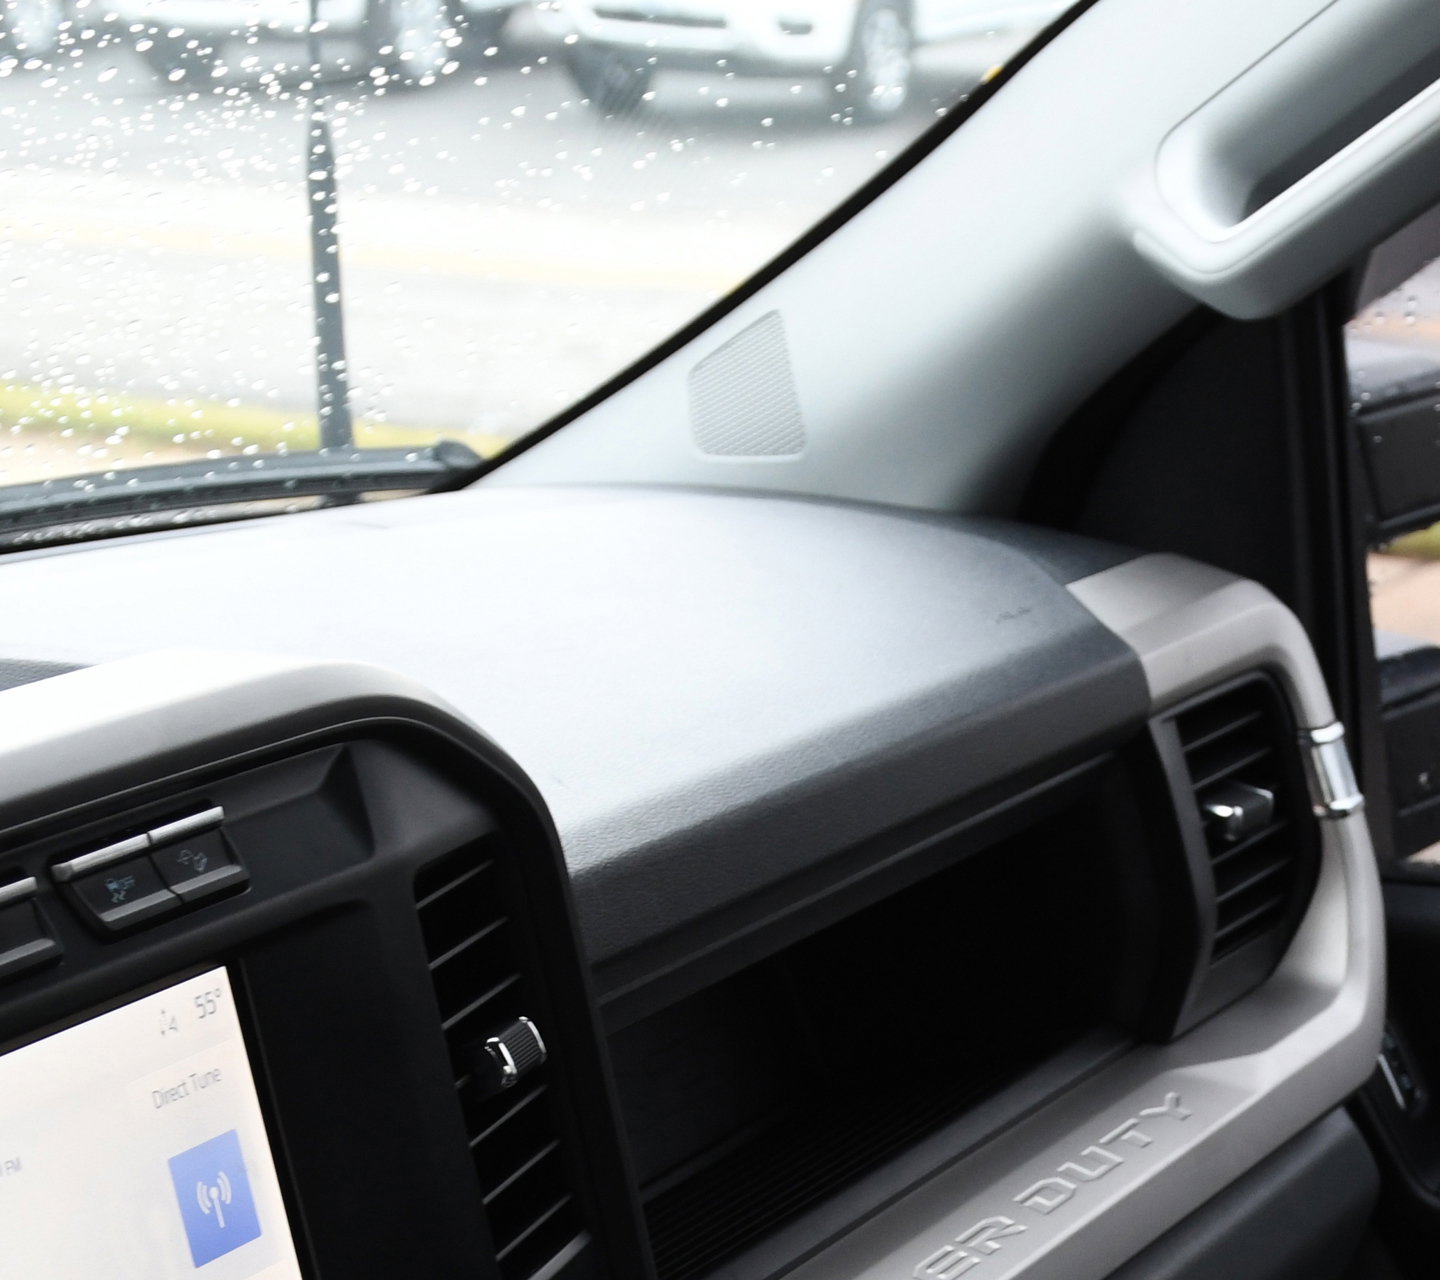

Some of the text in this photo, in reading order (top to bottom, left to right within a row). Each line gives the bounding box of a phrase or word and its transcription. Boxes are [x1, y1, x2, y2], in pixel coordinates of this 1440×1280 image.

[151, 1067, 222, 1110] Direct Tune
[1013, 1090, 1193, 1216] DUTY
